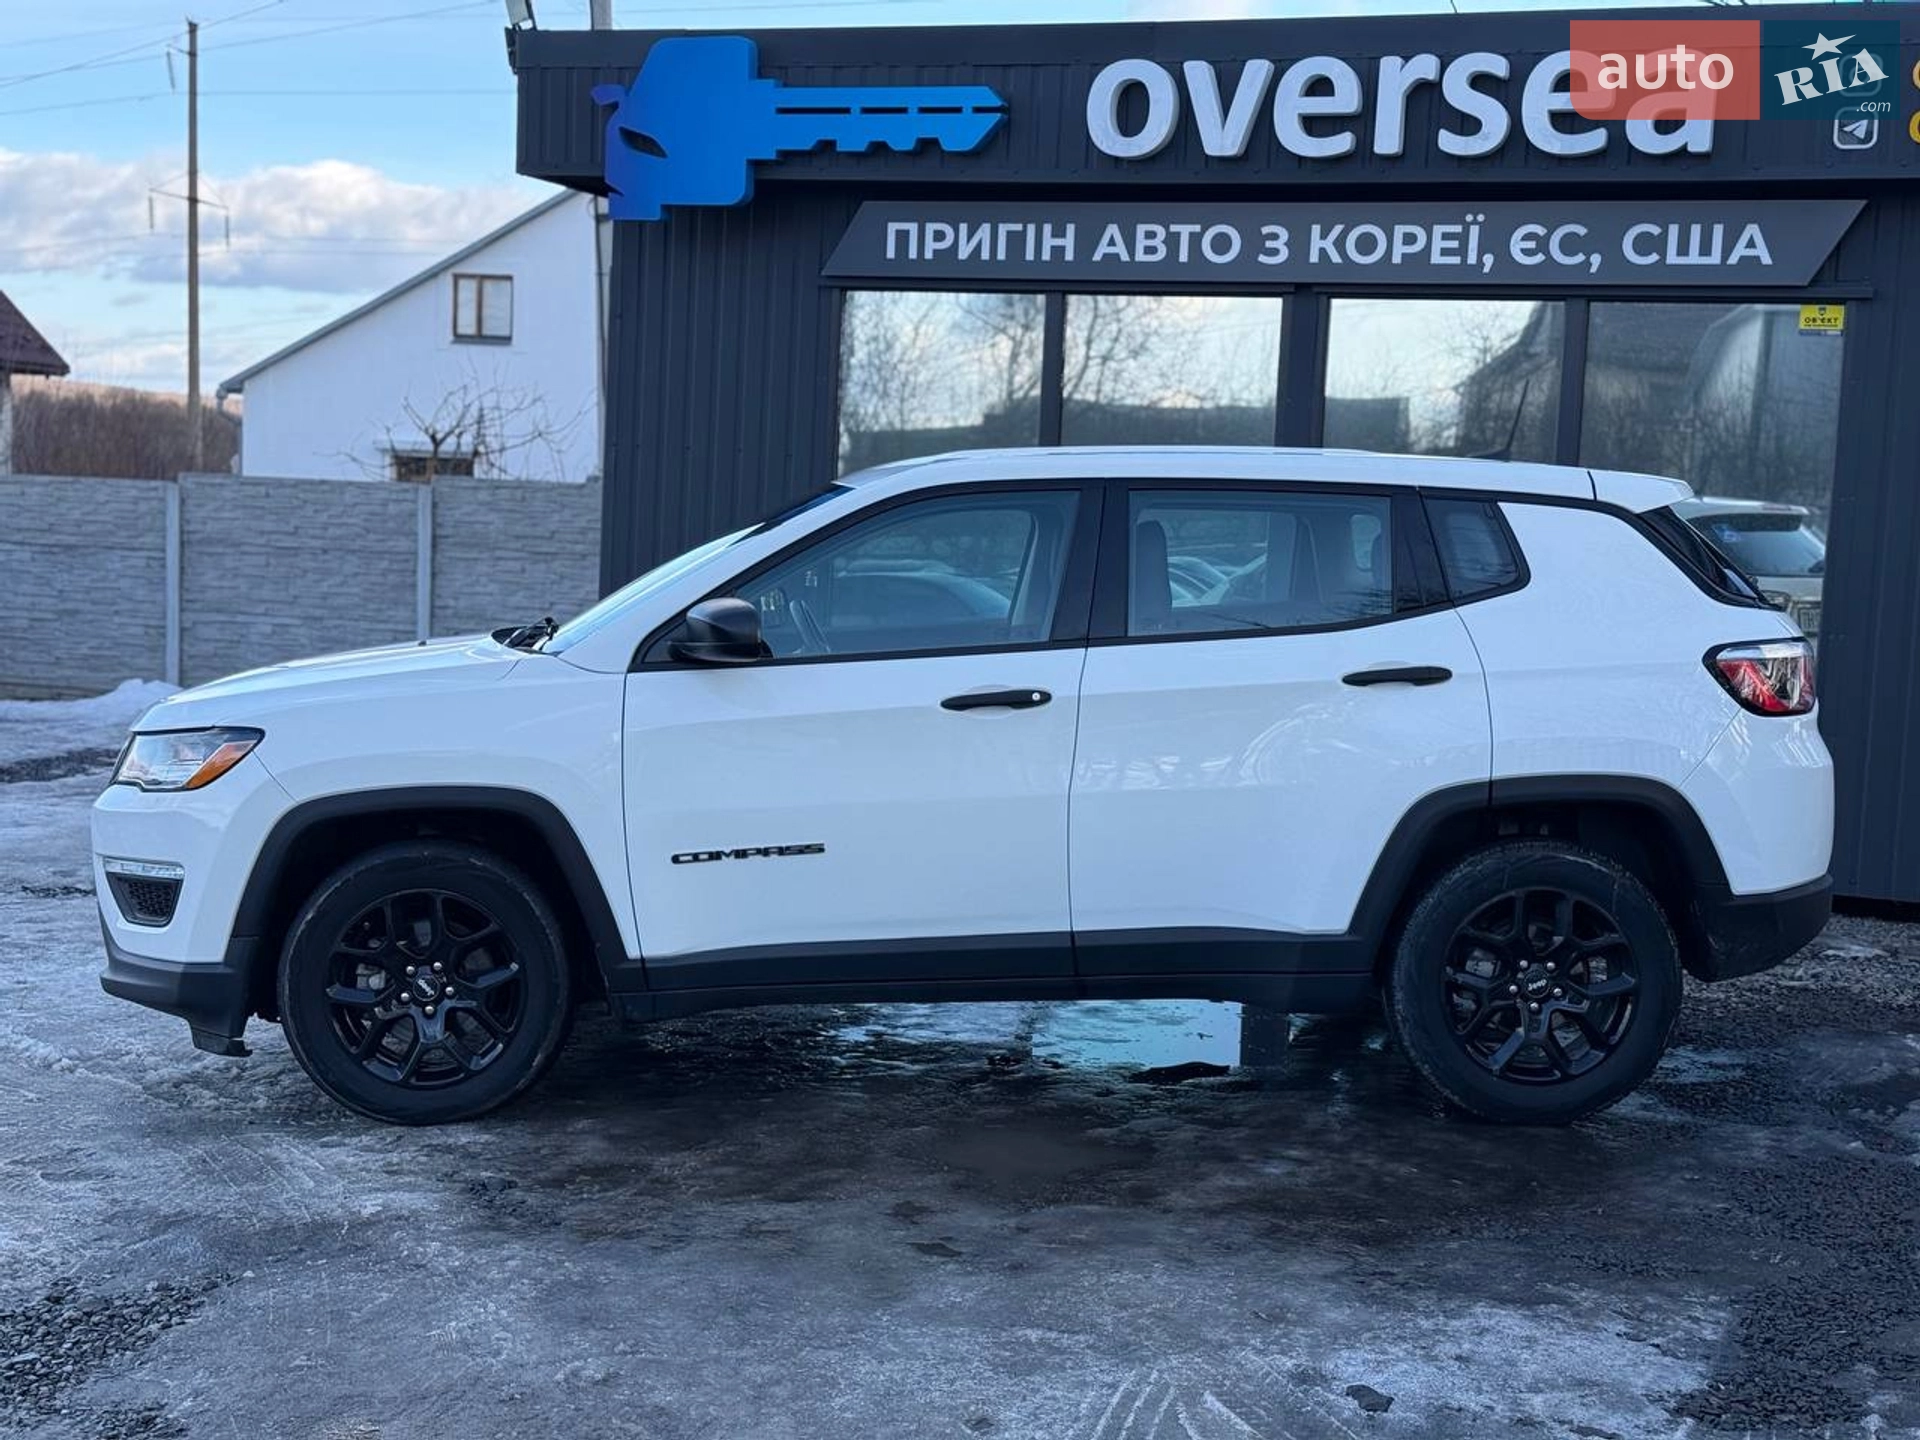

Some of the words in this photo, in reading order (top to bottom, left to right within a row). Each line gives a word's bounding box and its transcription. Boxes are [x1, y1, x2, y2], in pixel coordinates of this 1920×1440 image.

[1087, 50, 1716, 158] oversea
[886, 222, 1076, 261] ПРИГІН
[1092, 223, 1242, 264] АВТО
[1308, 214, 1495, 273] КОРЕЇ,
[1509, 223, 1602, 274] ЄС,
[1621, 223, 1773, 265] США
[671, 843, 825, 864] COMPASS
